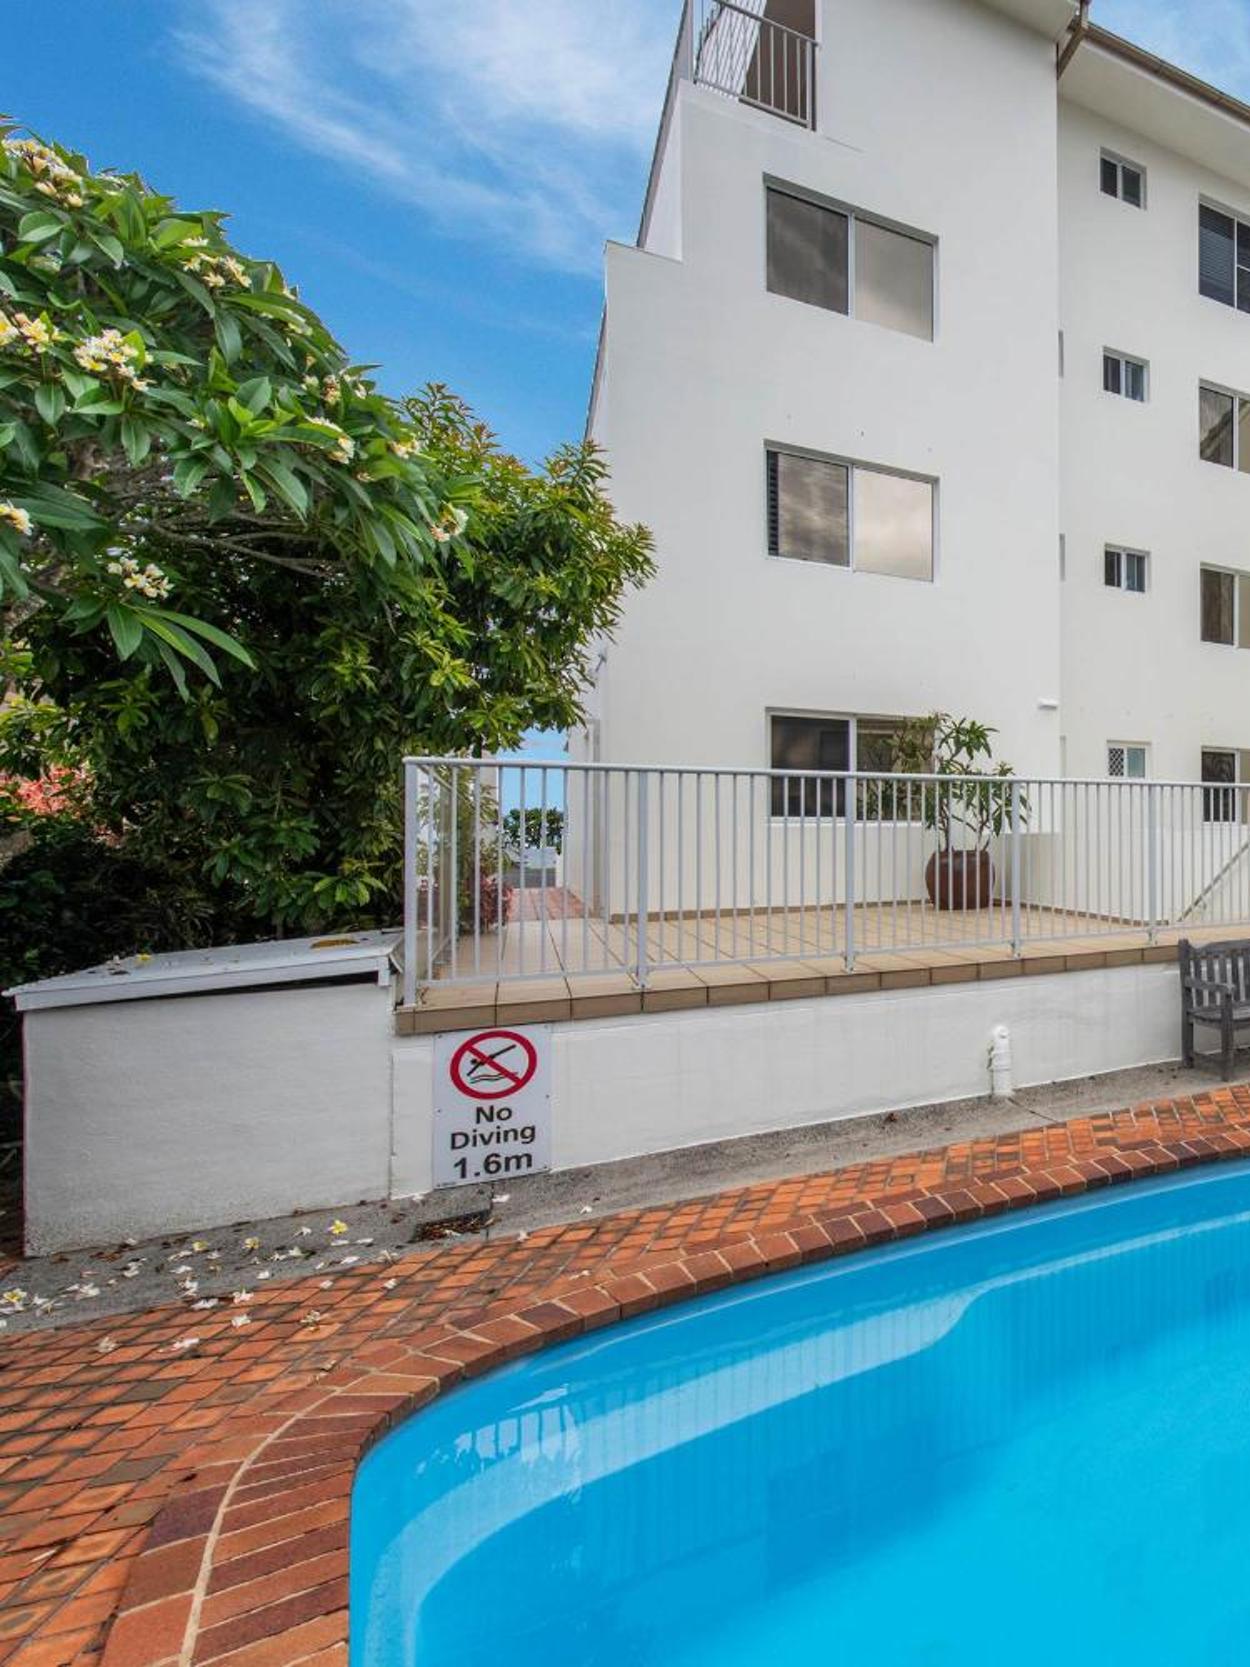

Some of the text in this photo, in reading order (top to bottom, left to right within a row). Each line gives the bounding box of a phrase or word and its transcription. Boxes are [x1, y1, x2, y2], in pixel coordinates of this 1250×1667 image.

[475, 1105, 512, 1124] No
[450, 1125, 536, 1150] Diving
[453, 1153, 532, 1178] 1.6m
